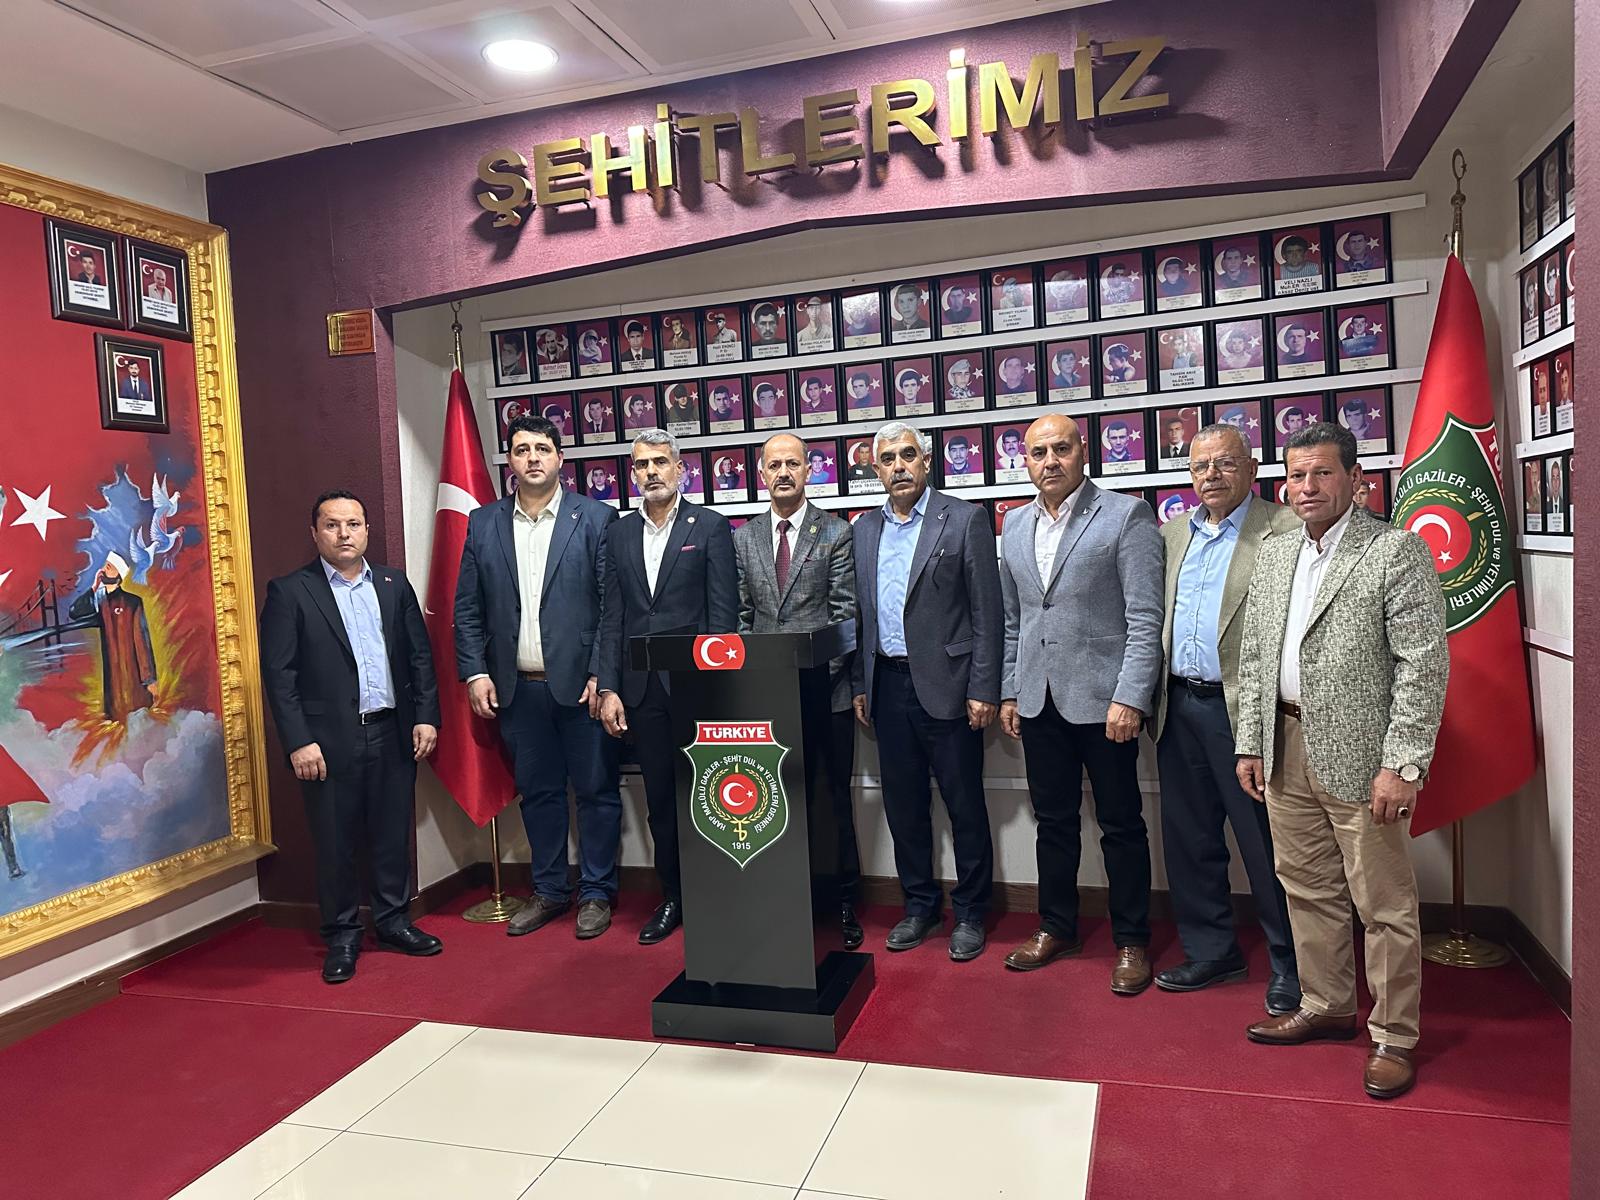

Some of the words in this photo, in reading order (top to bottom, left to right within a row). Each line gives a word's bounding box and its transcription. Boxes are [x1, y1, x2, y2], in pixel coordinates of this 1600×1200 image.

[476, 31, 1170, 228] ŞEHİTLERİMİZ
[1415, 468, 1466, 488] GAZİLER
[1470, 486, 1497, 518] ŞEHİT
[1490, 520, 1502, 545] DUL
[1492, 547, 1501, 560] ve
[1449, 562, 1500, 611] YETİMLERİ
[702, 726, 767, 739] TÜRKİYE
[722, 753, 743, 766] ŞEHİT
[743, 756, 757, 767] DUL
[756, 763, 765, 773] ve
[700, 760, 721, 785] GAZİLER
[763, 769, 779, 808] YETİMLERİ
[708, 815, 727, 832] HARP
[731, 842, 751, 850] 1915
